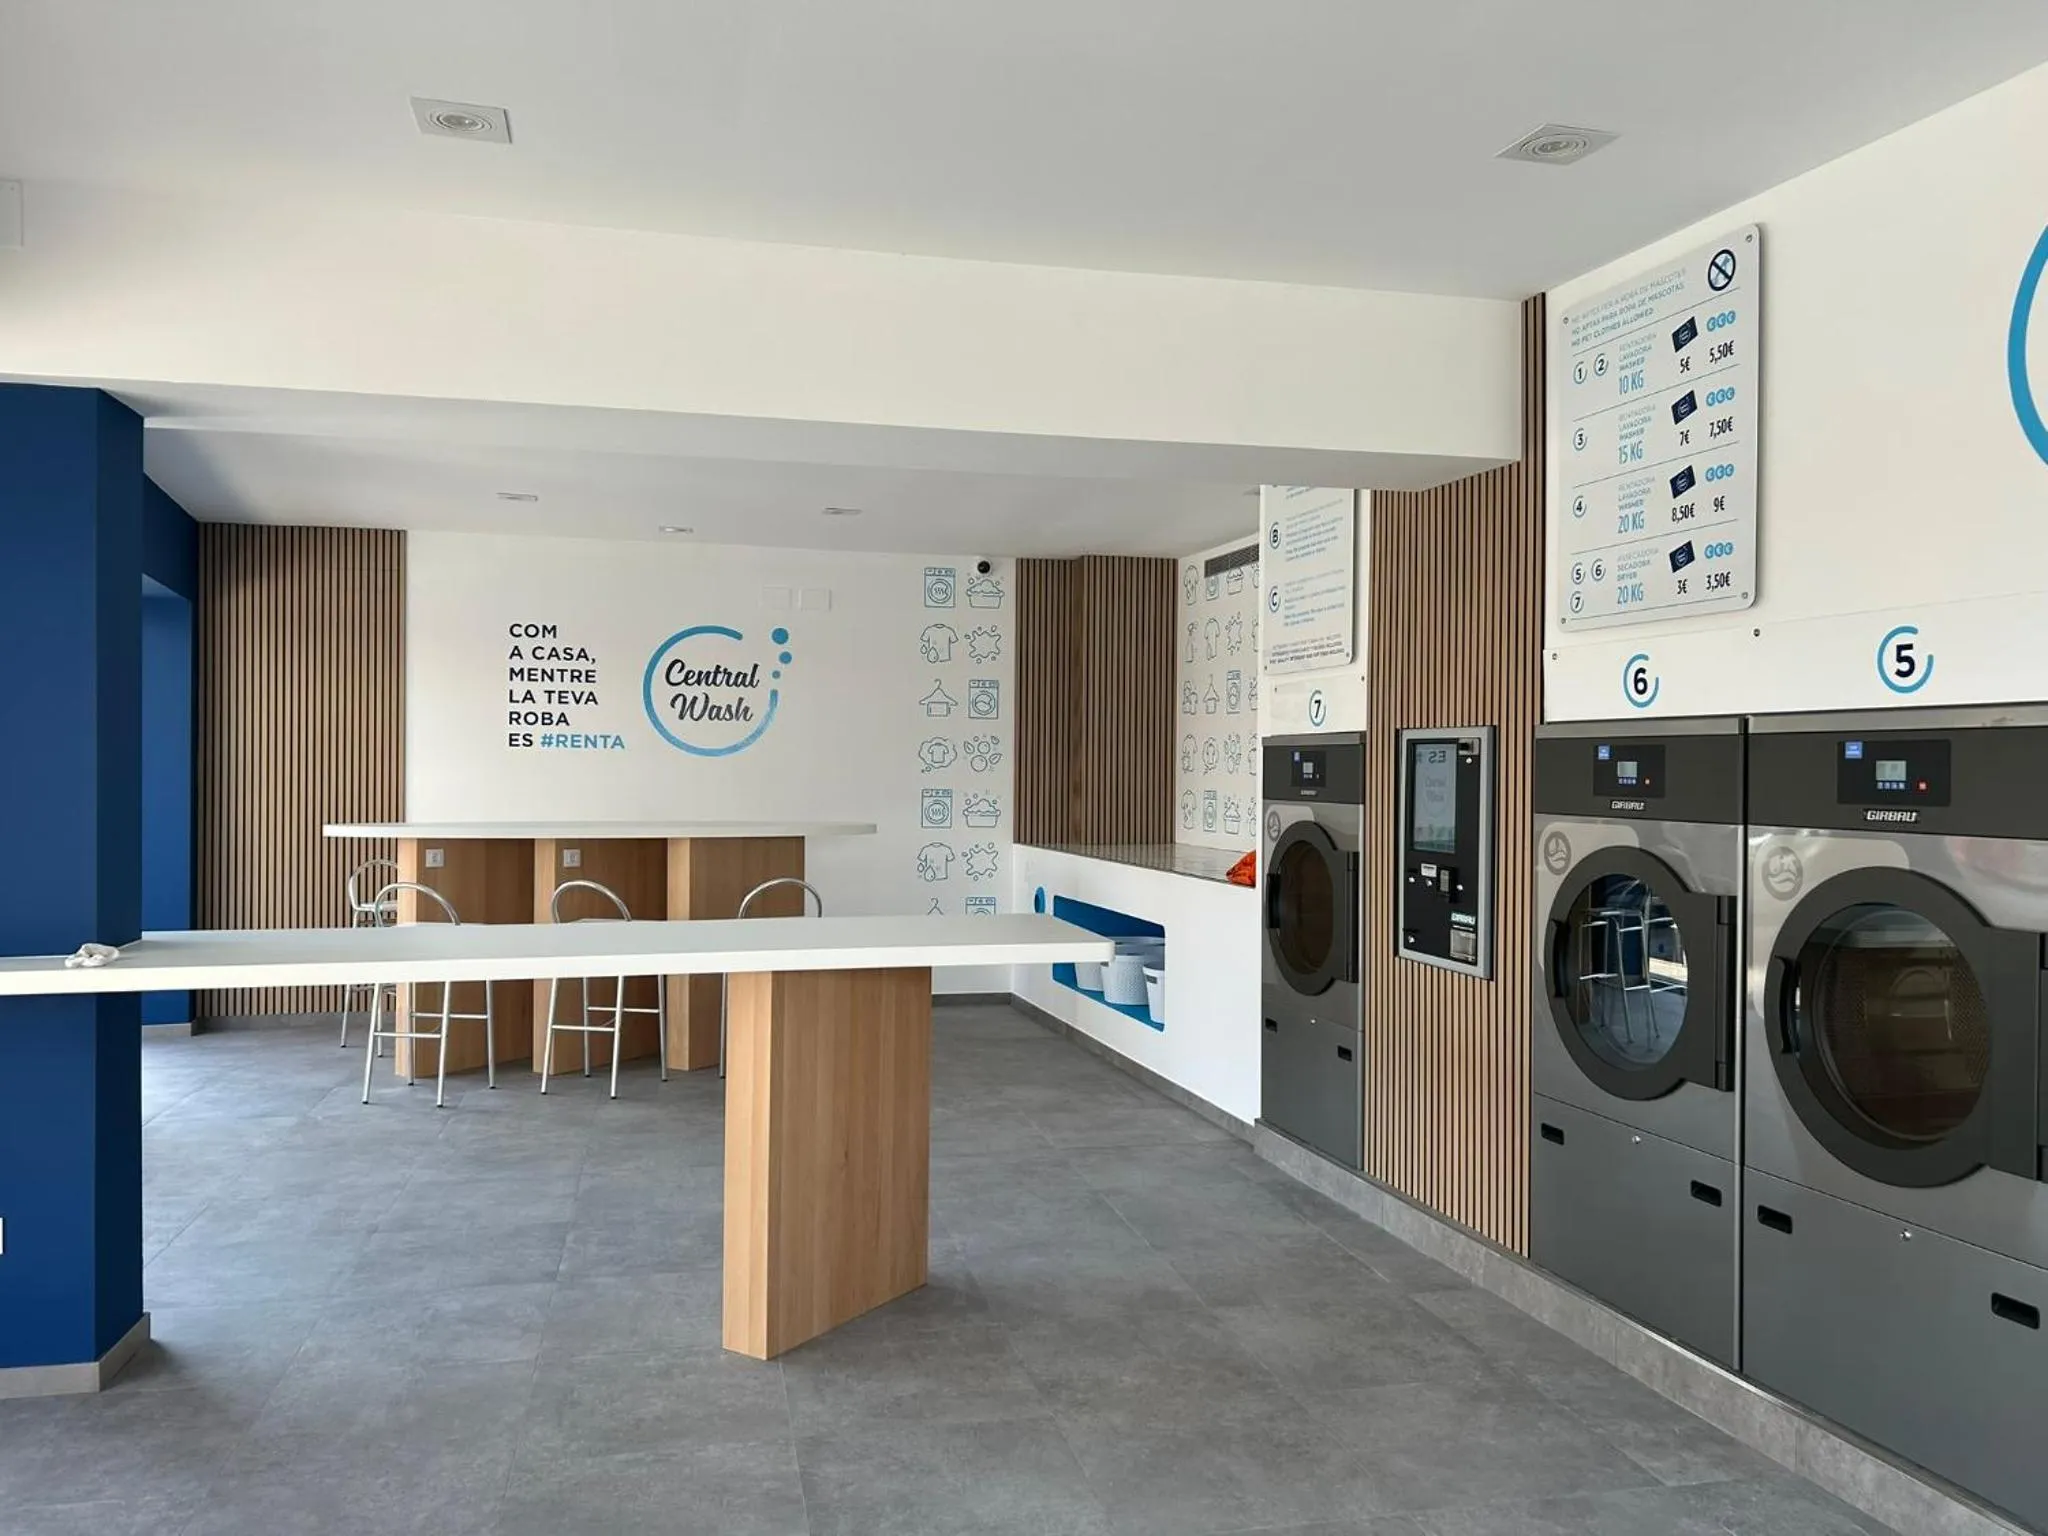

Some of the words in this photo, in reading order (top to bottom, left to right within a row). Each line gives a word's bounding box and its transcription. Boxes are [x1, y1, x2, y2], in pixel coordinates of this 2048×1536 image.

[1709, 340, 1734, 365] 5,50€
[1680, 357, 1691, 373] 5€
[1619, 375, 1628, 395] 10
[1631, 369, 1644, 391] KG
[1709, 416, 1733, 440] 7,50€
[1680, 430, 1690, 446] 7€
[1619, 444, 1628, 464] 15
[1630, 440, 1643, 461] KG
[1714, 495, 1725, 512] 9€
[1618, 514, 1629, 534] 20
[1632, 510, 1644, 530] KG
[1672, 503, 1695, 524] 8,50€
[1677, 579, 1688, 595] 3€
[1706, 571, 1731, 593] 3,50€
[1617, 585, 1628, 604] 20
[1631, 582, 1644, 602] KG
[509, 623, 557, 639] COM
[509, 646, 523, 661] A
[531, 646, 596, 664] CASA,
[1894, 643, 1916, 679] 5
[509, 667, 597, 683] MENTRE
[665, 658, 760, 689] Central
[1633, 667, 1648, 695] 6
[509, 690, 536, 704] LA
[544, 690, 599, 705] TEVA
[669, 692, 753, 722] Wash
[509, 711, 570, 726] ROBA
[509, 733, 534, 747] ES
[540, 733, 625, 749] #RENTA
[1611, 800, 1645, 811] GIRBAU
[1866, 809, 1917, 823] GIRBAU
